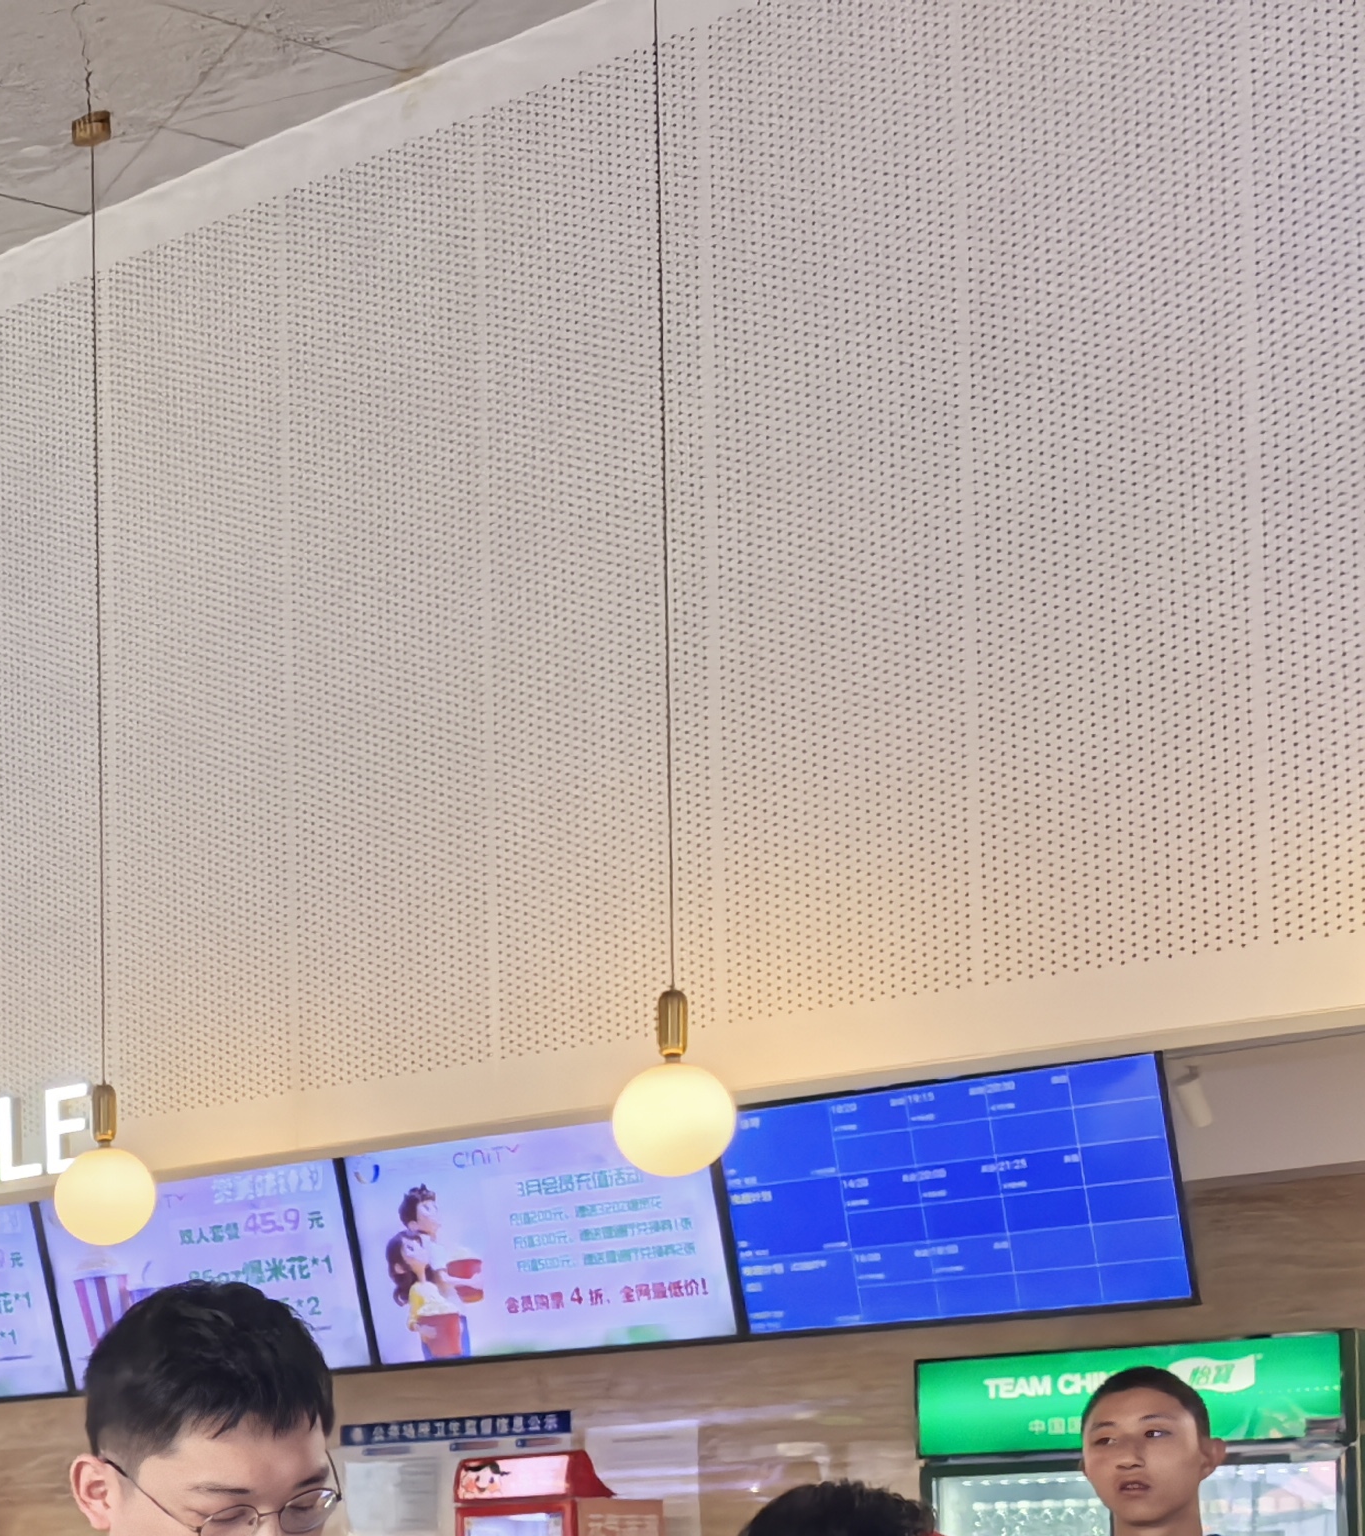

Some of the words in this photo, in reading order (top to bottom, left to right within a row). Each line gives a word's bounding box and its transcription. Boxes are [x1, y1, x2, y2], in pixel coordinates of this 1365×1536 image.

[243, 1207, 301, 1235] 45.9
[307, 1210, 326, 1231] 元
[9, 1251, 25, 1269] 元
[570, 1286, 584, 1305] 4
[982, 1374, 1052, 1399] TEAM
